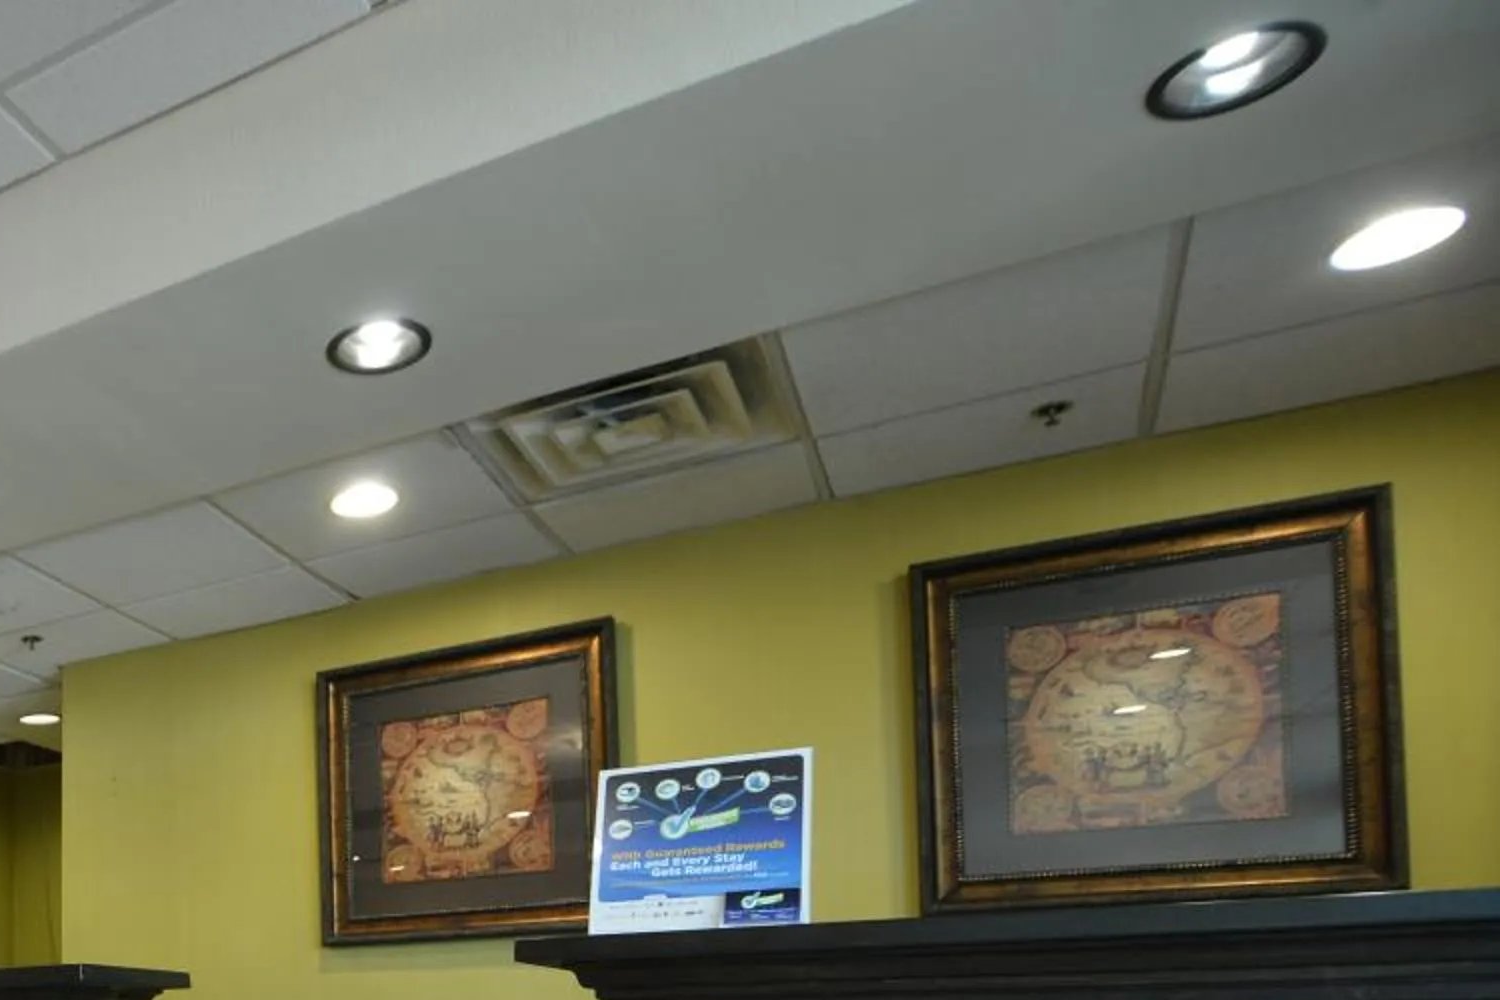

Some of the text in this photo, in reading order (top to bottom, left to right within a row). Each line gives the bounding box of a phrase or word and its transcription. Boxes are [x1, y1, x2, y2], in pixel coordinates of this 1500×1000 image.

[610, 852, 745, 871] Each and Every Stay
[651, 860, 757, 877] Gets Rewarded!
